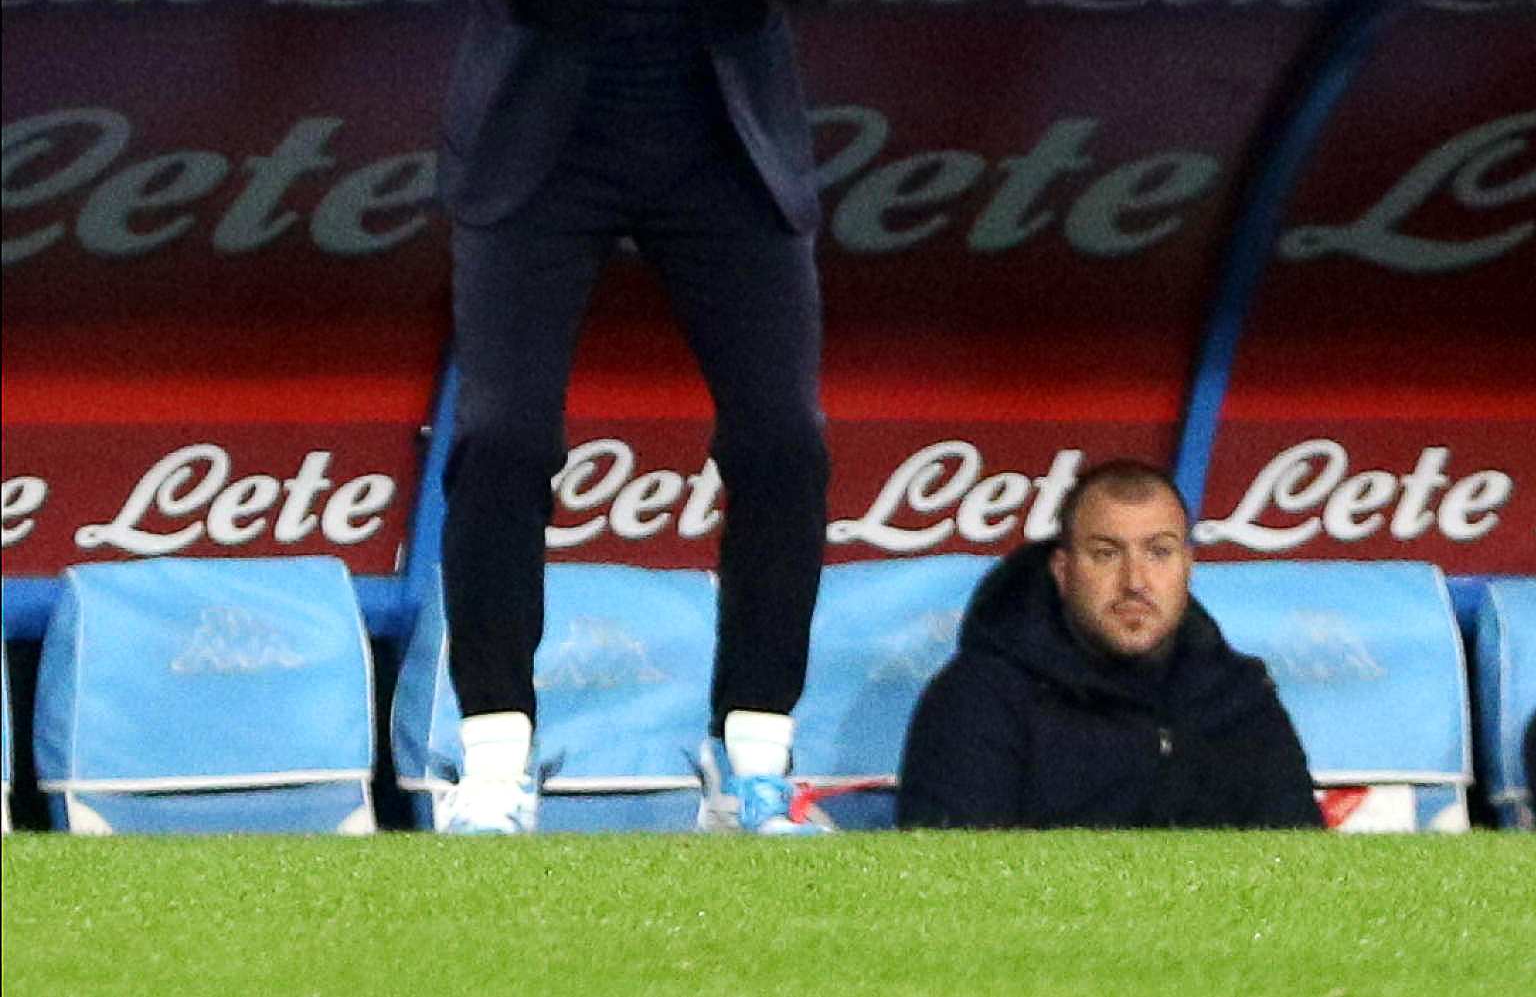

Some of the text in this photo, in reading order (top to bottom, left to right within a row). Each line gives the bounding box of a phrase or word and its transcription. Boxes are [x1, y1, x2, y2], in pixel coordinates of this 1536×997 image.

[75, 442, 397, 556] Lete
[544, 438, 726, 550] Let
[826, 439, 1086, 552] Let
[1193, 438, 1514, 552] Lete
